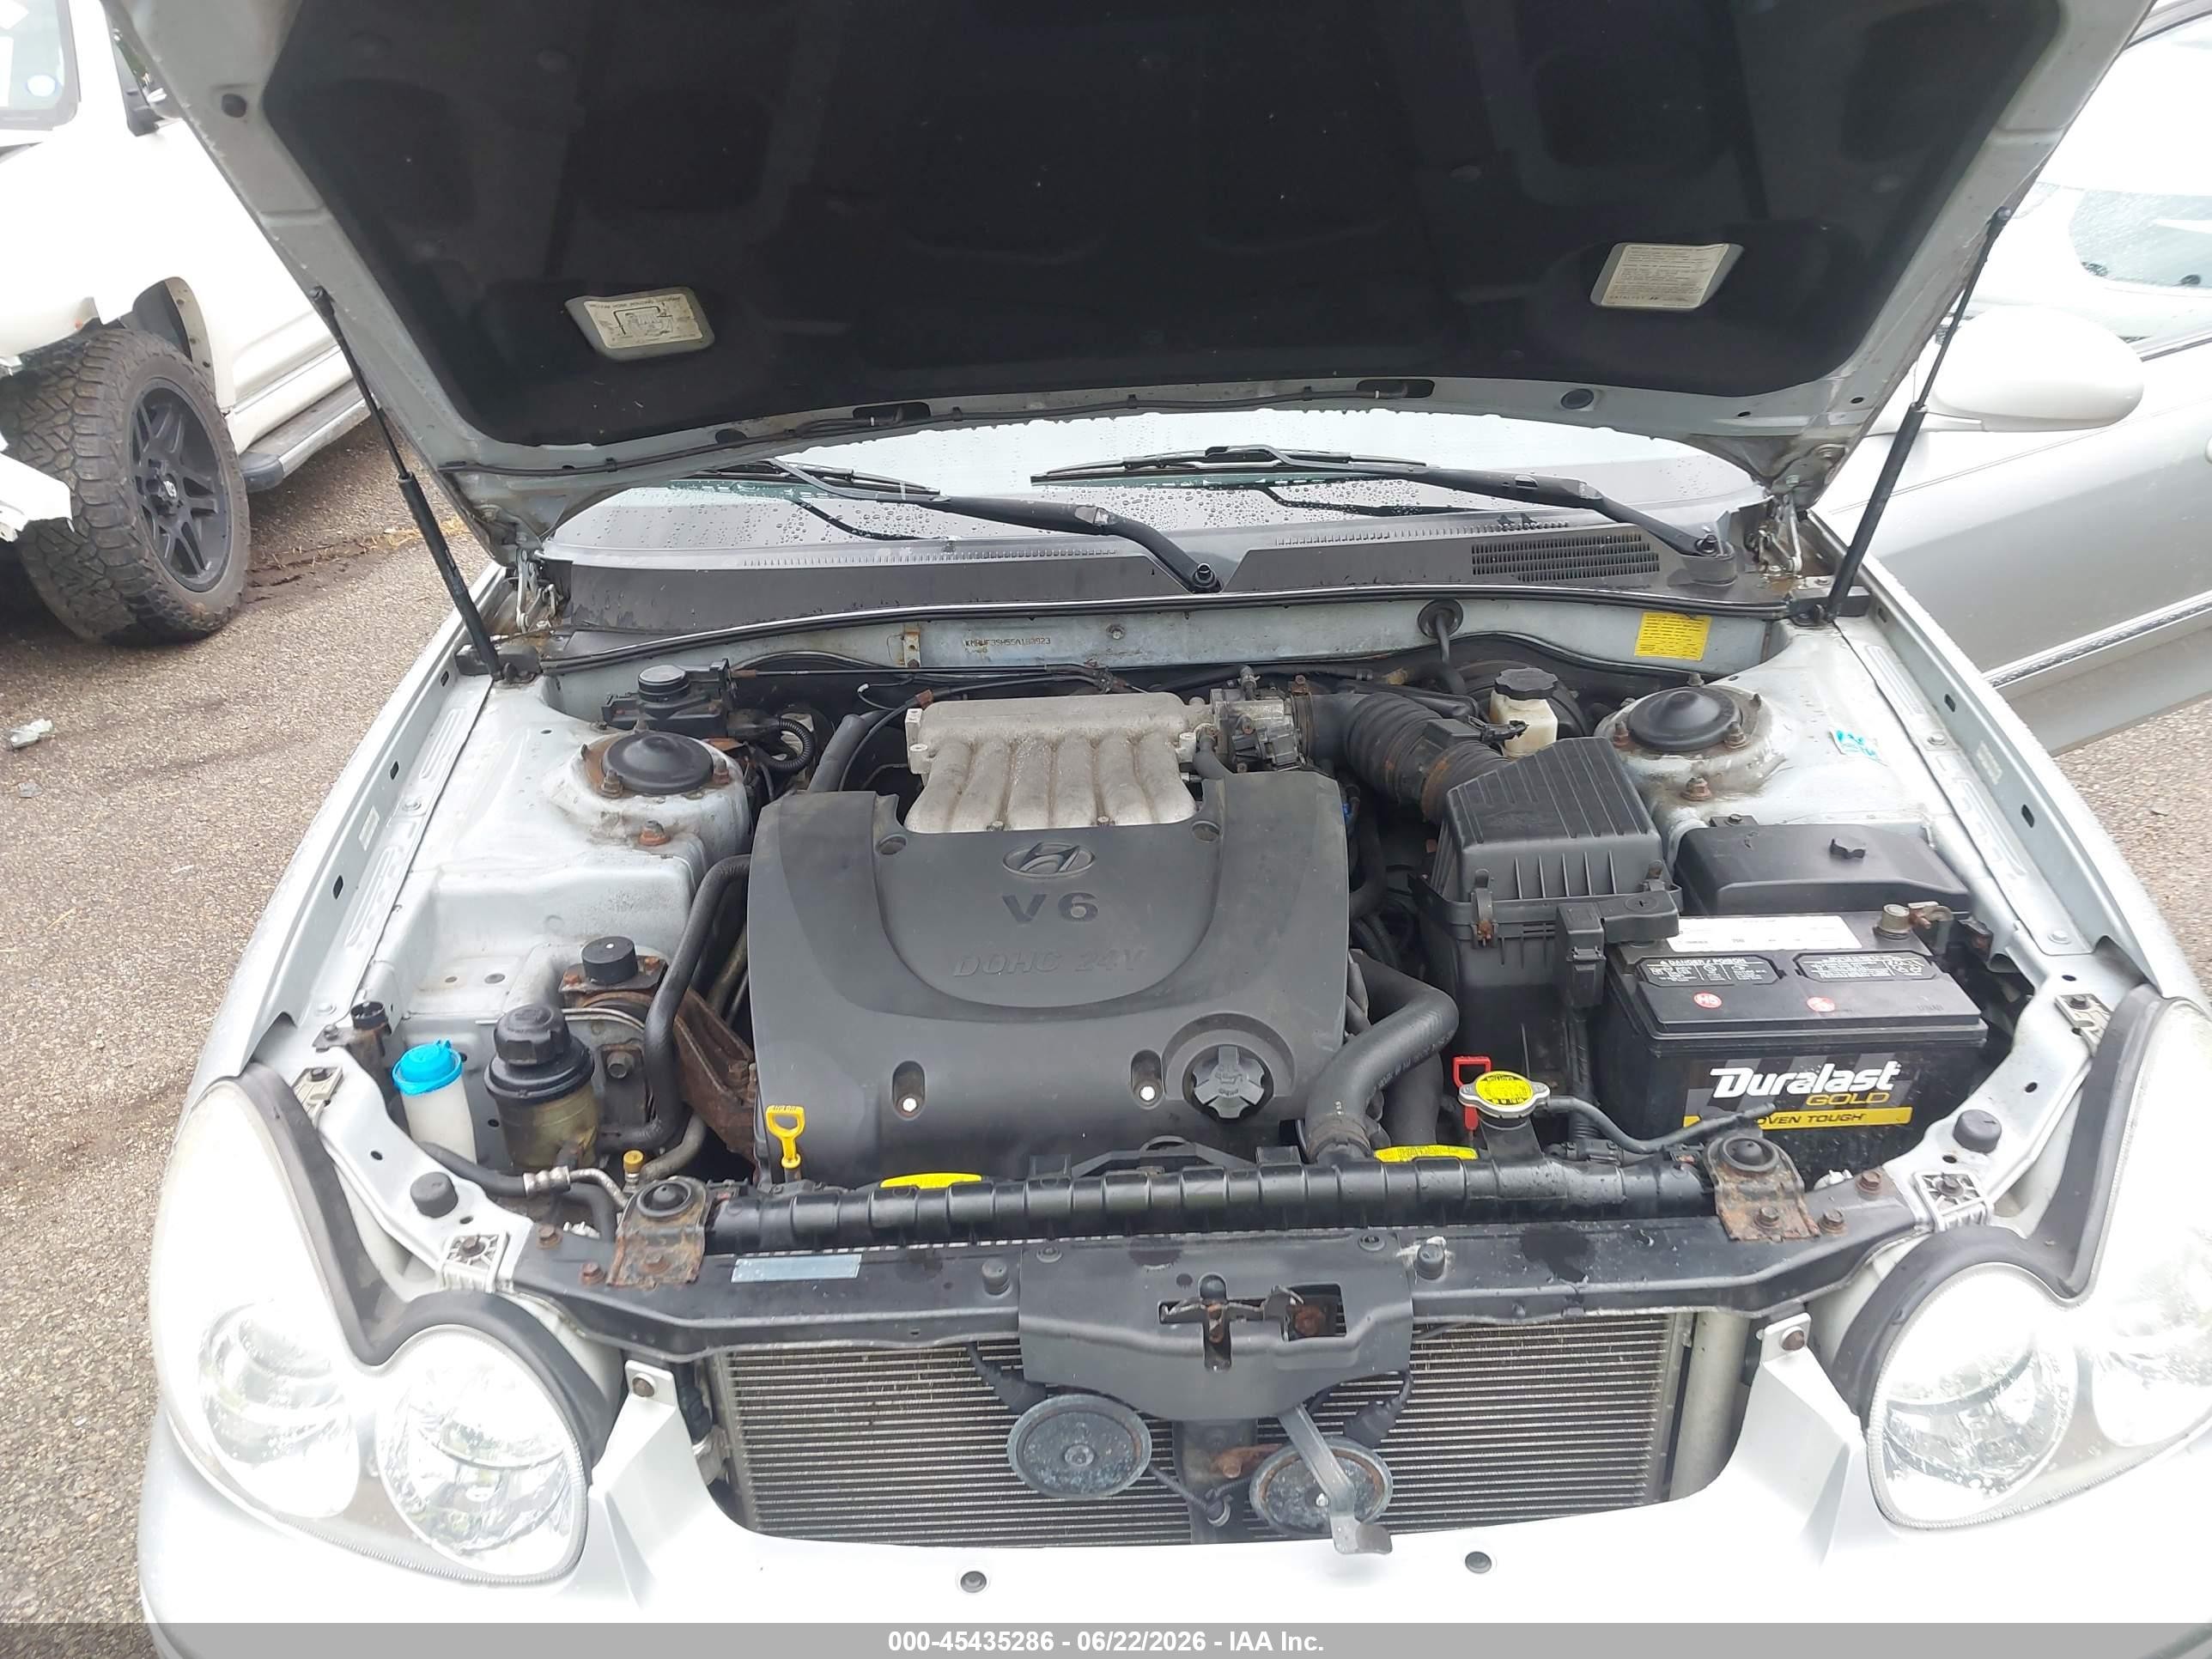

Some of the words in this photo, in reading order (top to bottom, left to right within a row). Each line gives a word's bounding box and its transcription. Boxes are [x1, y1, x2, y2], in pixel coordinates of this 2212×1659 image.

[953, 950, 1062, 977] DOHC
[1074, 948, 1146, 973] 24V
[1710, 1060, 1901, 1098] Duralast
[1806, 1091, 1891, 1107] GOLD
[1757, 1115, 1802, 1125] OVEN
[1807, 1114, 1864, 1122] TOUGH
